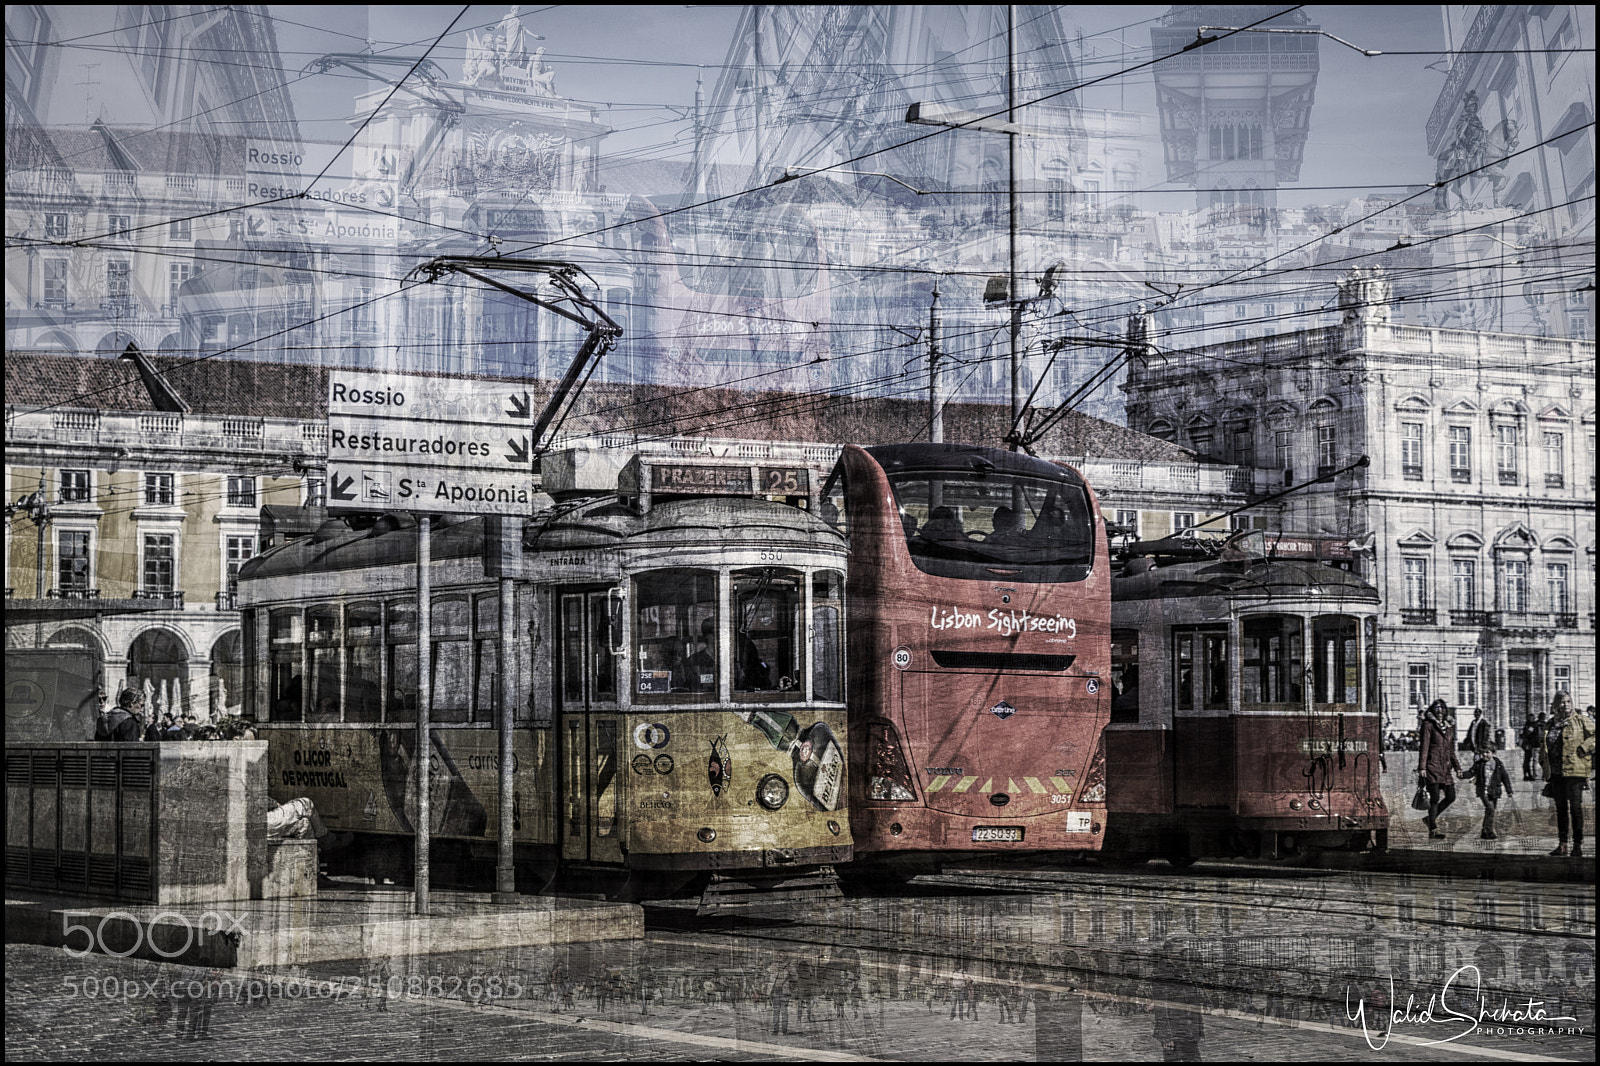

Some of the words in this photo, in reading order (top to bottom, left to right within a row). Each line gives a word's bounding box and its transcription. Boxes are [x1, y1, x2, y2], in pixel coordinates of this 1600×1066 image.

[248, 148, 303, 167] Rossio
[247, 183, 367, 204] Restauradores
[324, 221, 396, 239] Apolónia
[695, 315, 734, 333] Lisbon
[333, 382, 405, 406] Rossio
[331, 429, 490, 456] Restauradores
[769, 471, 798, 491] 25
[434, 480, 529, 504] Apolónia
[550, 557, 586, 566] ENTRADA
[760, 549, 783, 562] 550
[930, 605, 982, 631] Lisbon
[986, 608, 1077, 639] Sightseeing
[896, 653, 908, 662] 80
[640, 682, 653, 691] 04
[294, 749, 302, 766] O
[303, 749, 331, 766] LICOR
[468, 749, 500, 770] carris
[282, 770, 296, 786] DE
[296, 770, 348, 789] PORTUGAL
[925, 767, 964, 776] VOLVO
[1050, 794, 1072, 804] 3051
[1078, 817, 1090, 827] TP
